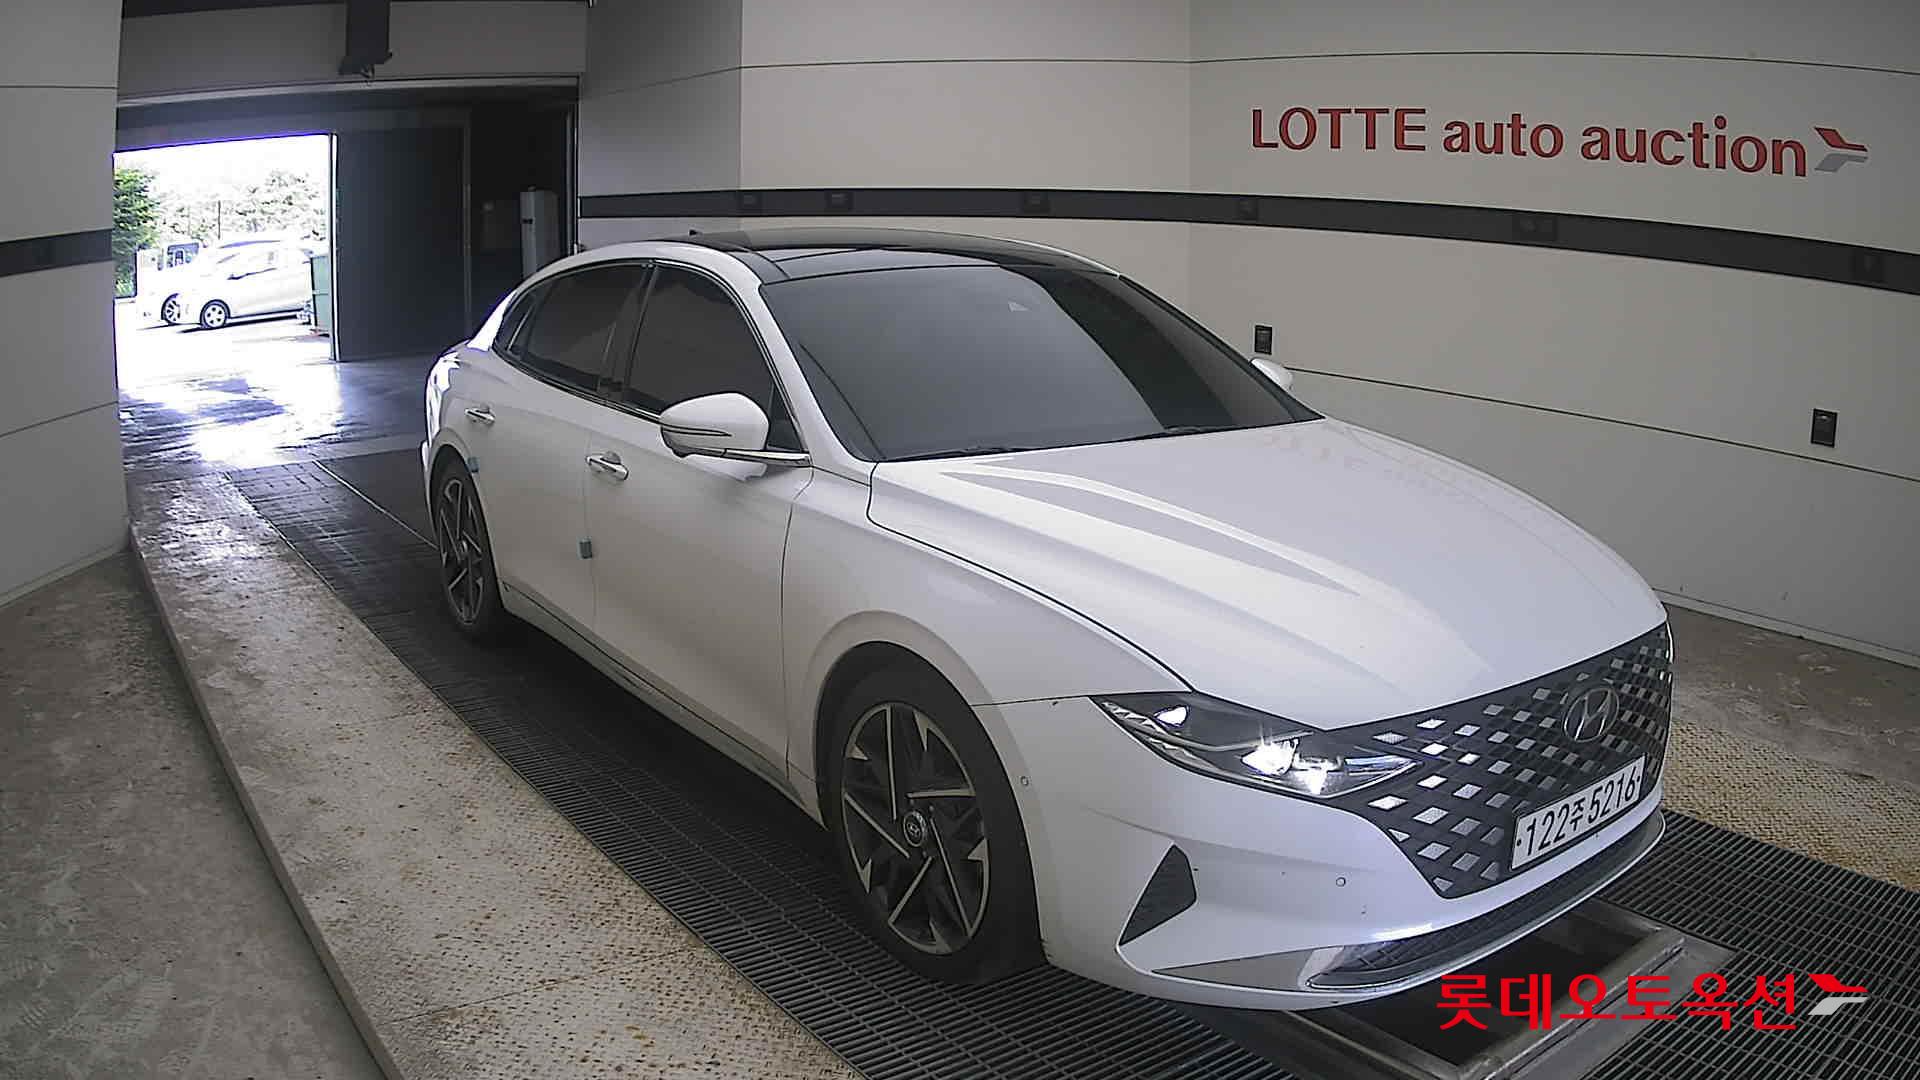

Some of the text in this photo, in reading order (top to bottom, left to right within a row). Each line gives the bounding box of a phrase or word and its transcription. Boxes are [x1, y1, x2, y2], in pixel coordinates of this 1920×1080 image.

[1252, 107, 1808, 177] LOTTE auto auction
